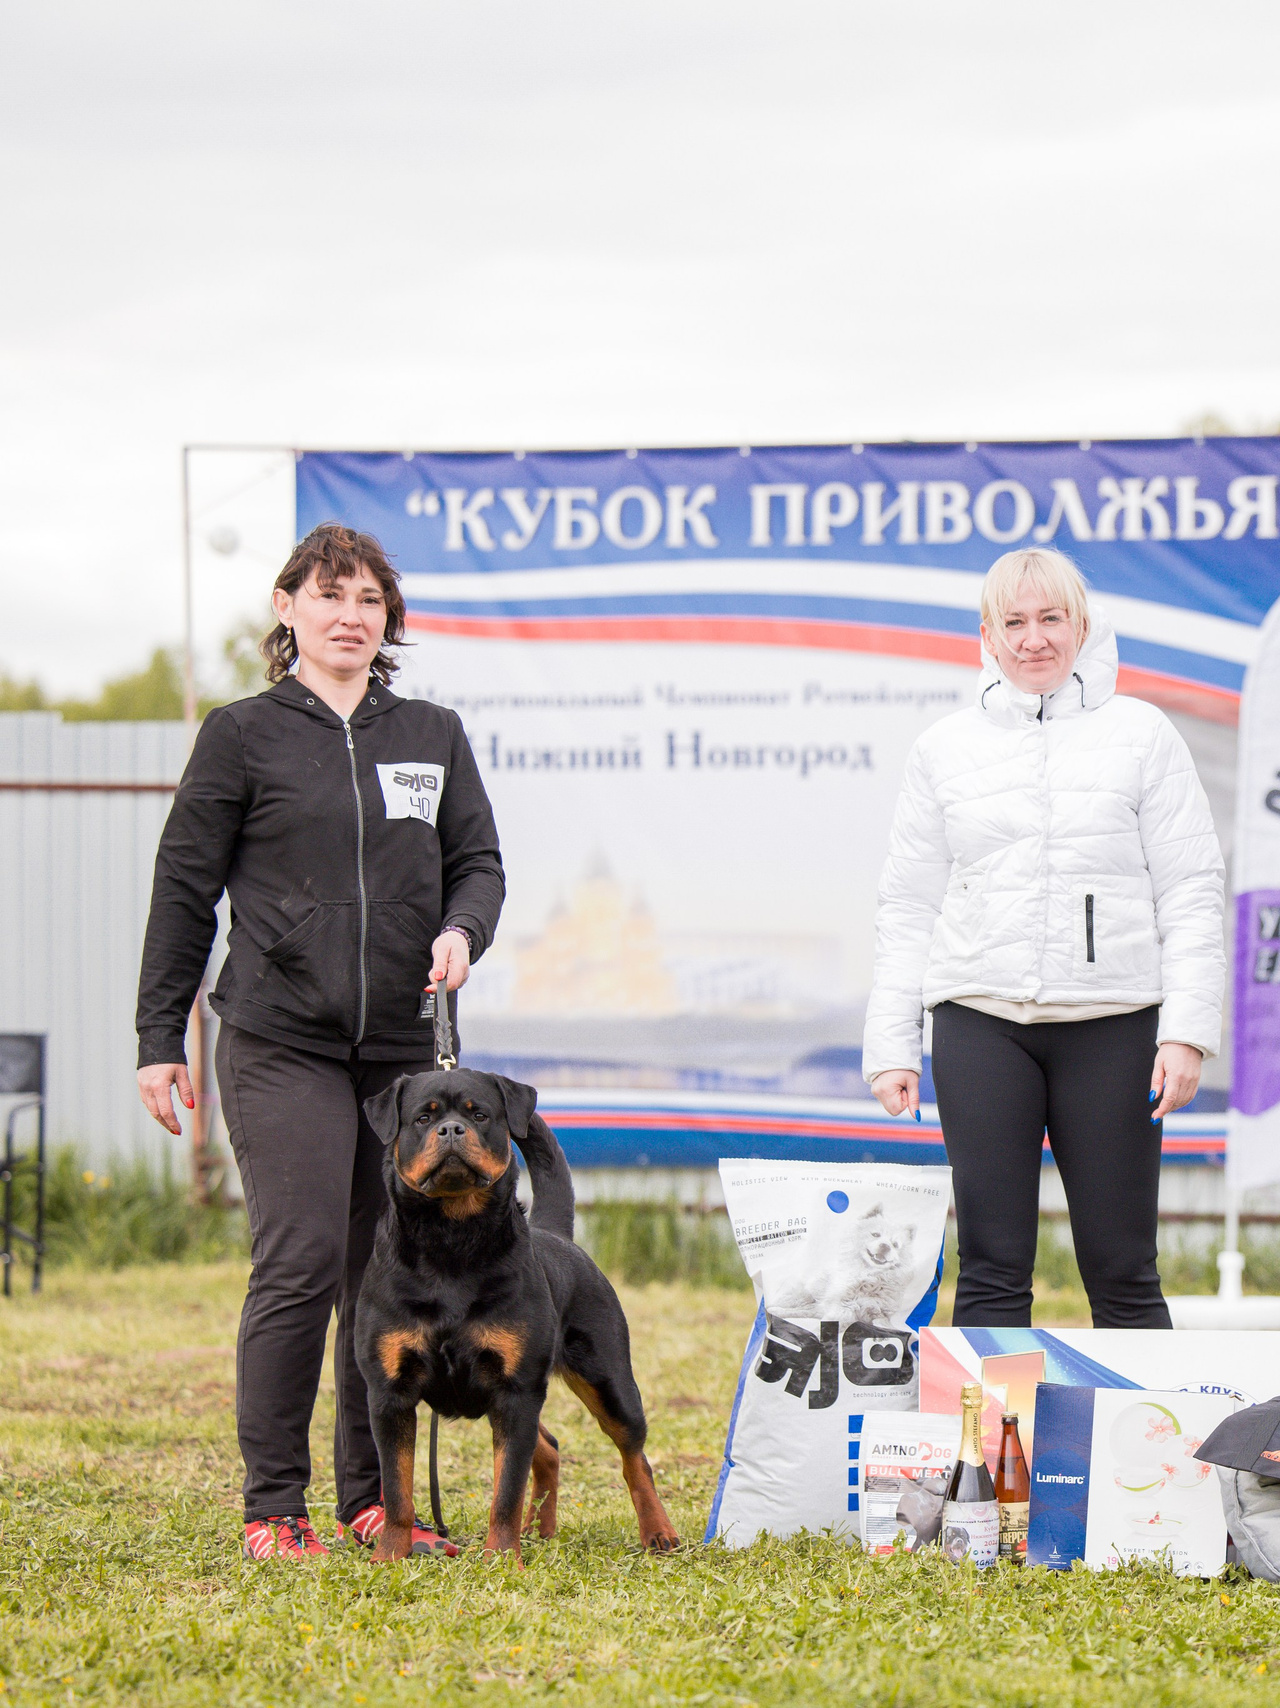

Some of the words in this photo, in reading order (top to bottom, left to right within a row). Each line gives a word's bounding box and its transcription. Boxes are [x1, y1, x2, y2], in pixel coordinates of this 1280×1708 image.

[666, 730, 875, 779] Новгород
[409, 796, 431, 819] 40
[731, 1177, 766, 1187] HOLISTIC
[923, 1188, 940, 1196] FREE
[735, 1220, 780, 1237] BREEDER
[787, 1216, 807, 1227] BAG
[870, 1466, 904, 1477] BULL
[912, 1468, 951, 1479] MEAT
[1036, 1472, 1085, 1484] Luminarc
[1107, 1556, 1117, 1565] 19
